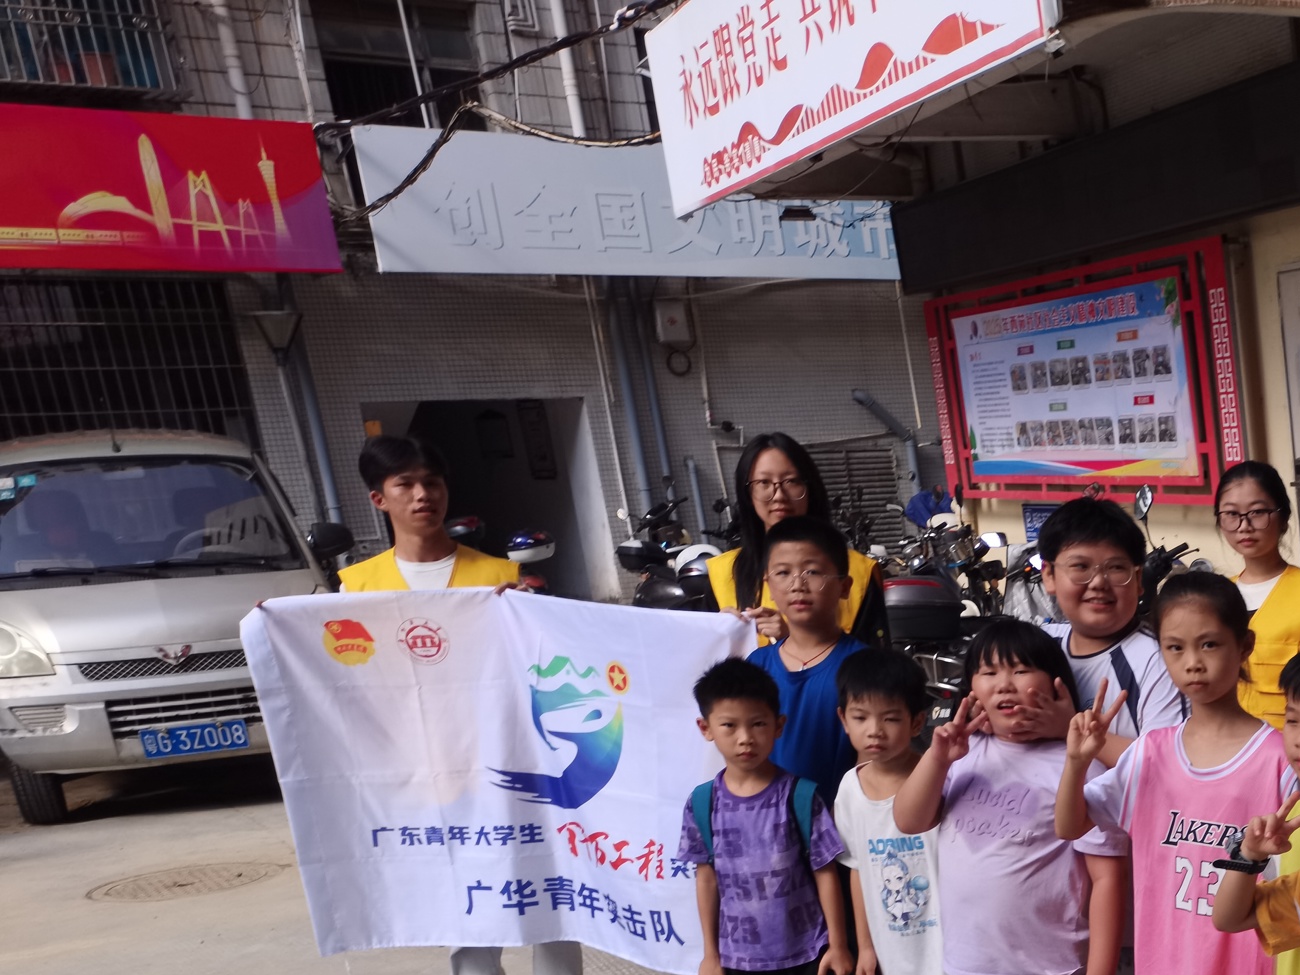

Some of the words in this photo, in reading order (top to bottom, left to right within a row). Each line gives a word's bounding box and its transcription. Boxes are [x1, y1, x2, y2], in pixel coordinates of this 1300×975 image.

[677, 0, 789, 130] 永远跟党走
[371, 823, 545, 848] 广东青年大学生
[1174, 855, 1227, 917] 23
